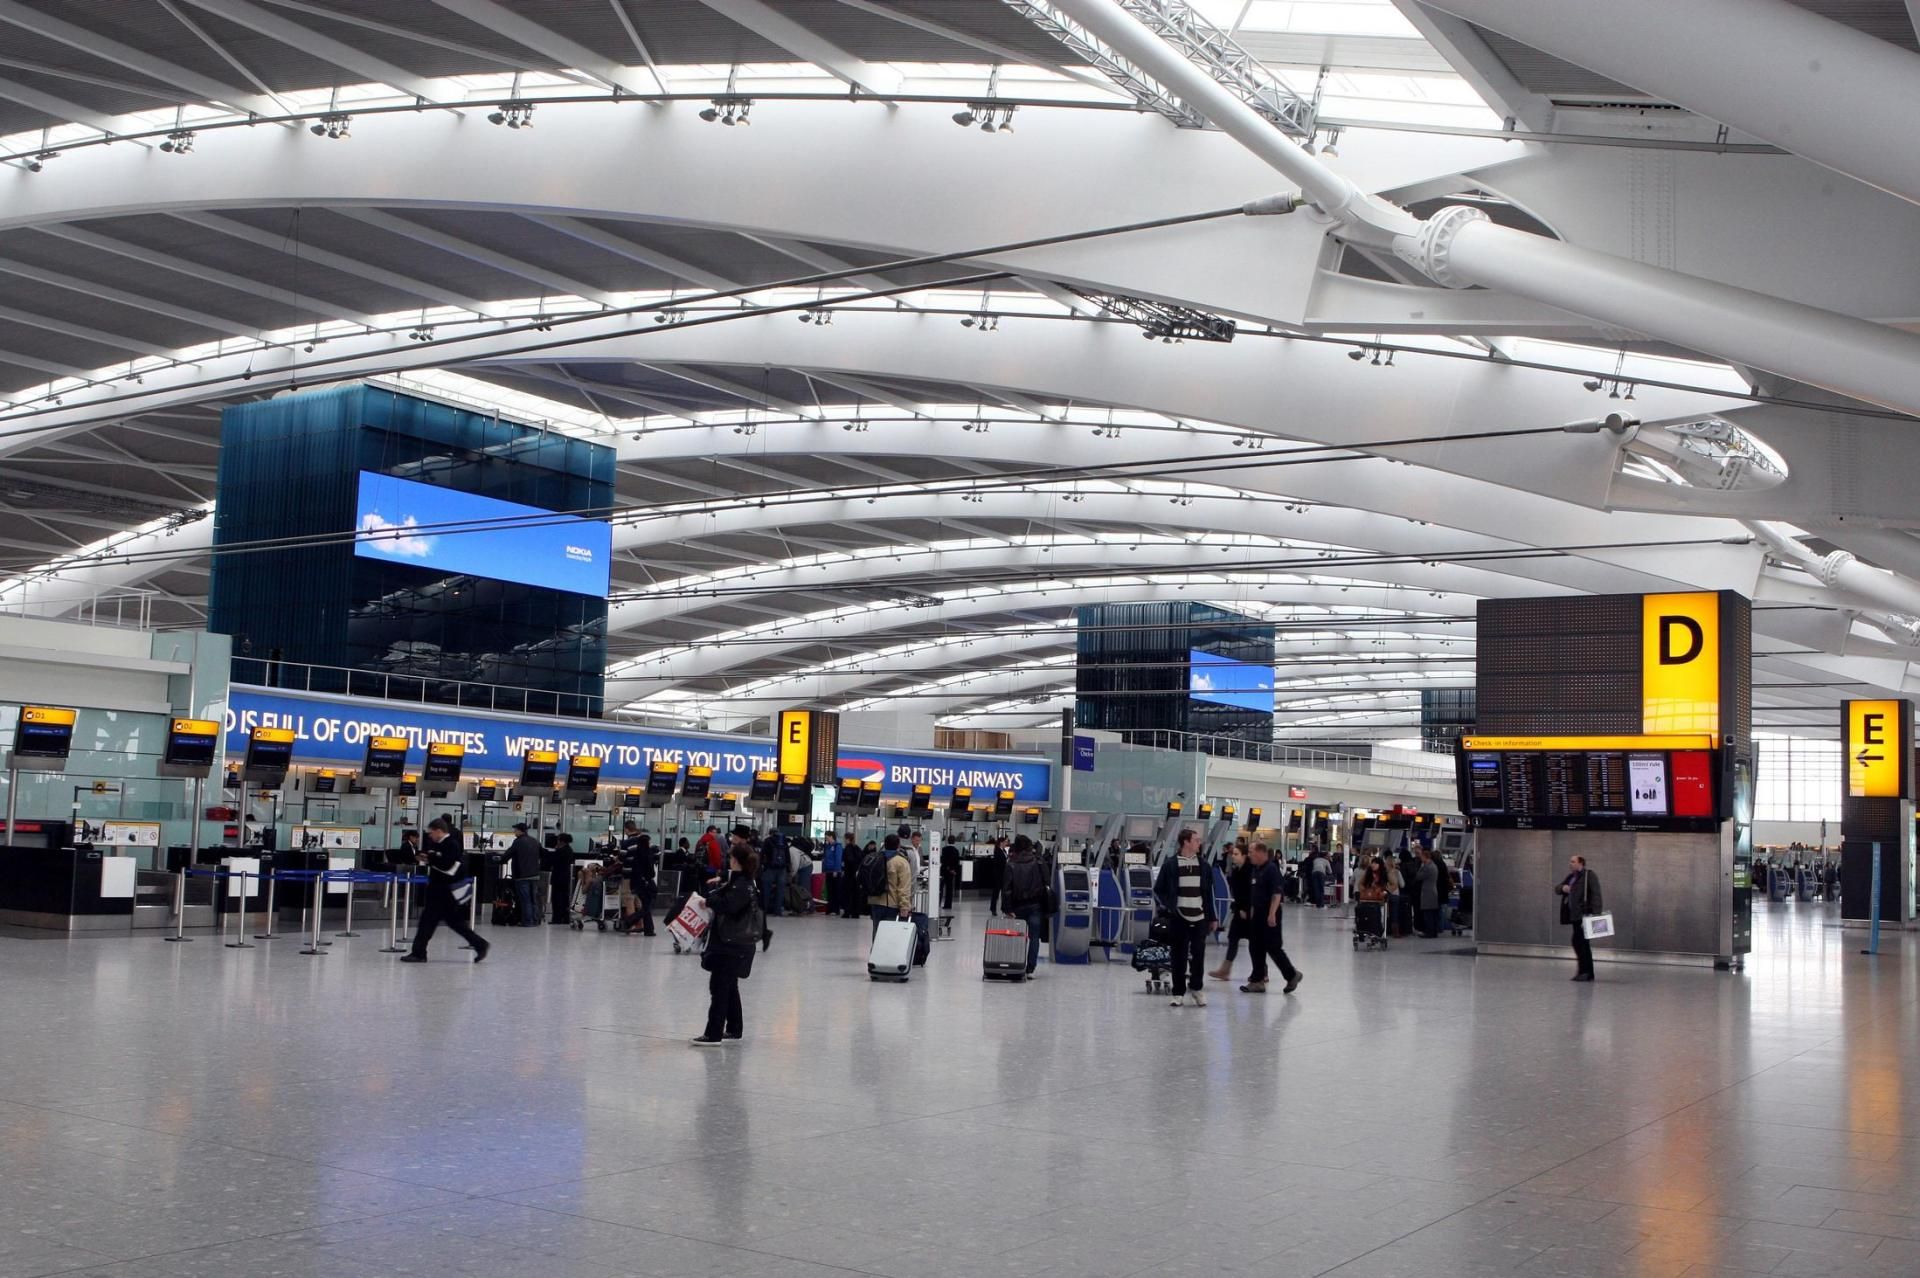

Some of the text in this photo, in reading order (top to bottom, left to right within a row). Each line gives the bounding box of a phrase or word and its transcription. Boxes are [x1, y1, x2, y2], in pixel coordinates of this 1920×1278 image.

[566, 545, 592, 557] NOKIA
[1659, 615, 1704, 665] D
[241, 710, 258, 734] IS
[313, 718, 341, 742] OF
[559, 740, 614, 764] READY
[616, 745, 640, 766] TO
[643, 747, 684, 769] TAKE
[687, 750, 720, 772] YOU
[723, 753, 746, 773] TO
[790, 721, 802, 744] E
[1864, 713, 1884, 745] E
[891, 765, 1023, 790] BRITISH AIRWAYS
